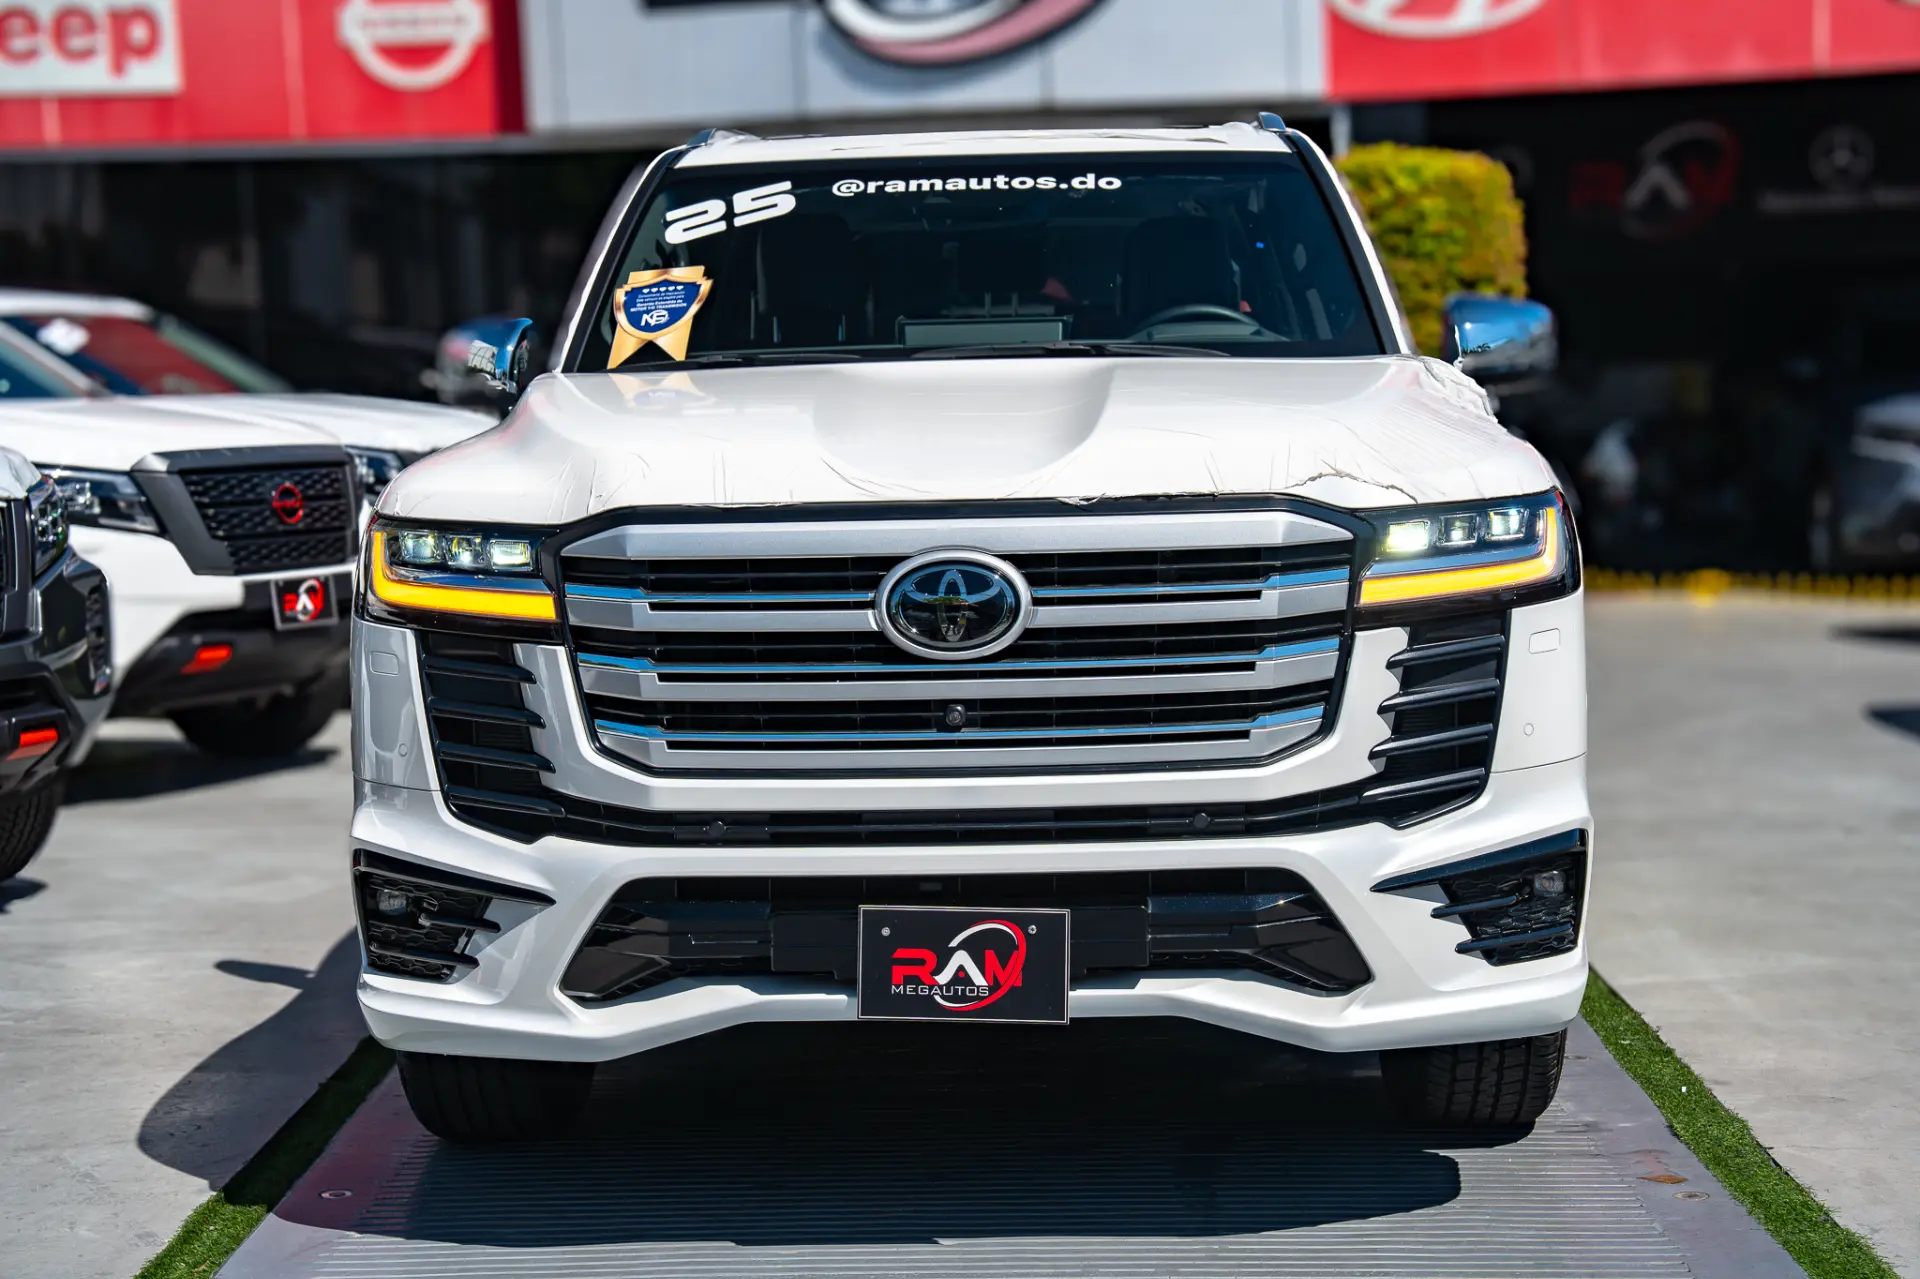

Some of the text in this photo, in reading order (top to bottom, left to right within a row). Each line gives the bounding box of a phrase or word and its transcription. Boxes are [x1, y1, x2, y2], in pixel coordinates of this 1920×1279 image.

[832, 173, 1122, 197] @ramautos.do
[664, 180, 796, 244] 25
[891, 947, 1023, 987] RAM
[890, 984, 990, 997] MEGAUTOS
